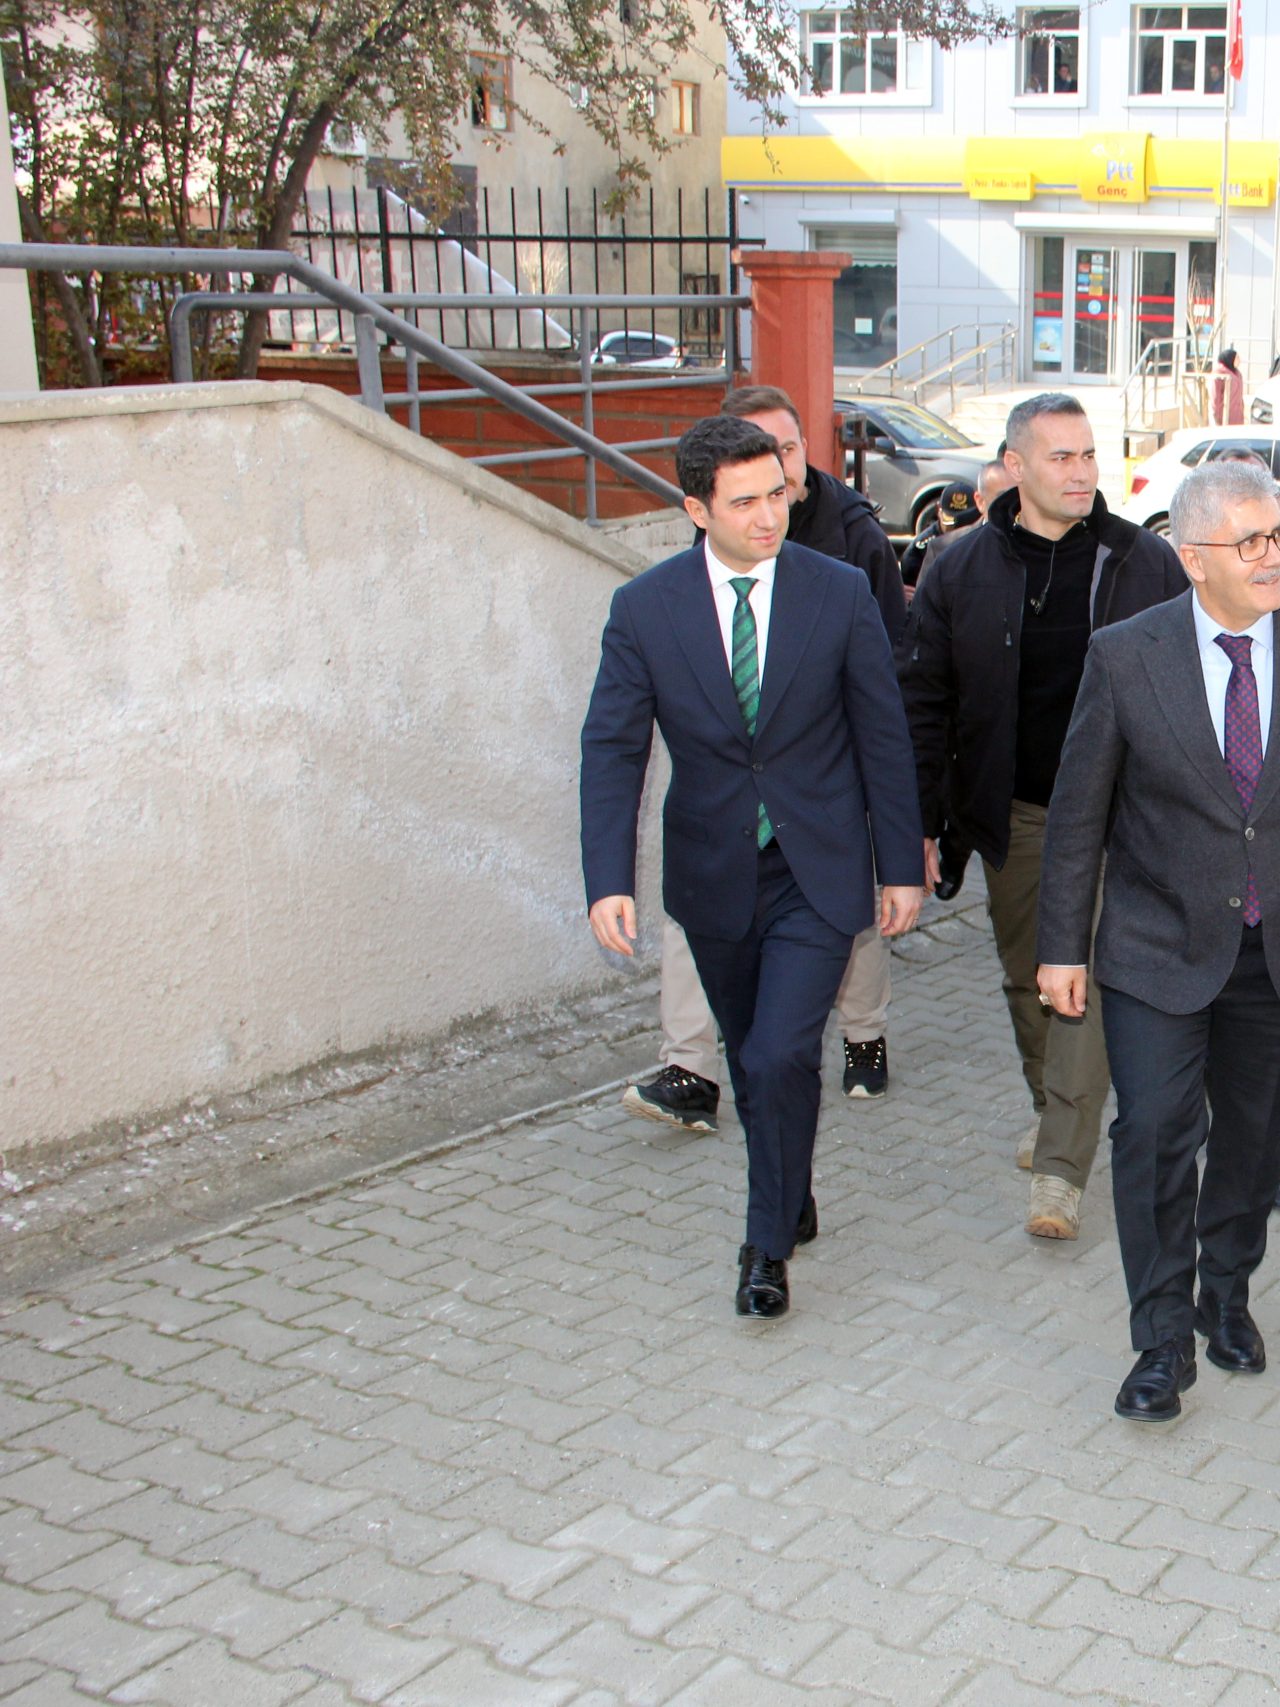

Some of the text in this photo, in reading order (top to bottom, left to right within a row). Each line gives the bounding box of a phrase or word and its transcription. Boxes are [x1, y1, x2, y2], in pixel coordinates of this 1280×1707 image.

[1106, 160, 1134, 181] Ptt
[1097, 185, 1127, 198] Genç
[1242, 183, 1264, 198] Bank
